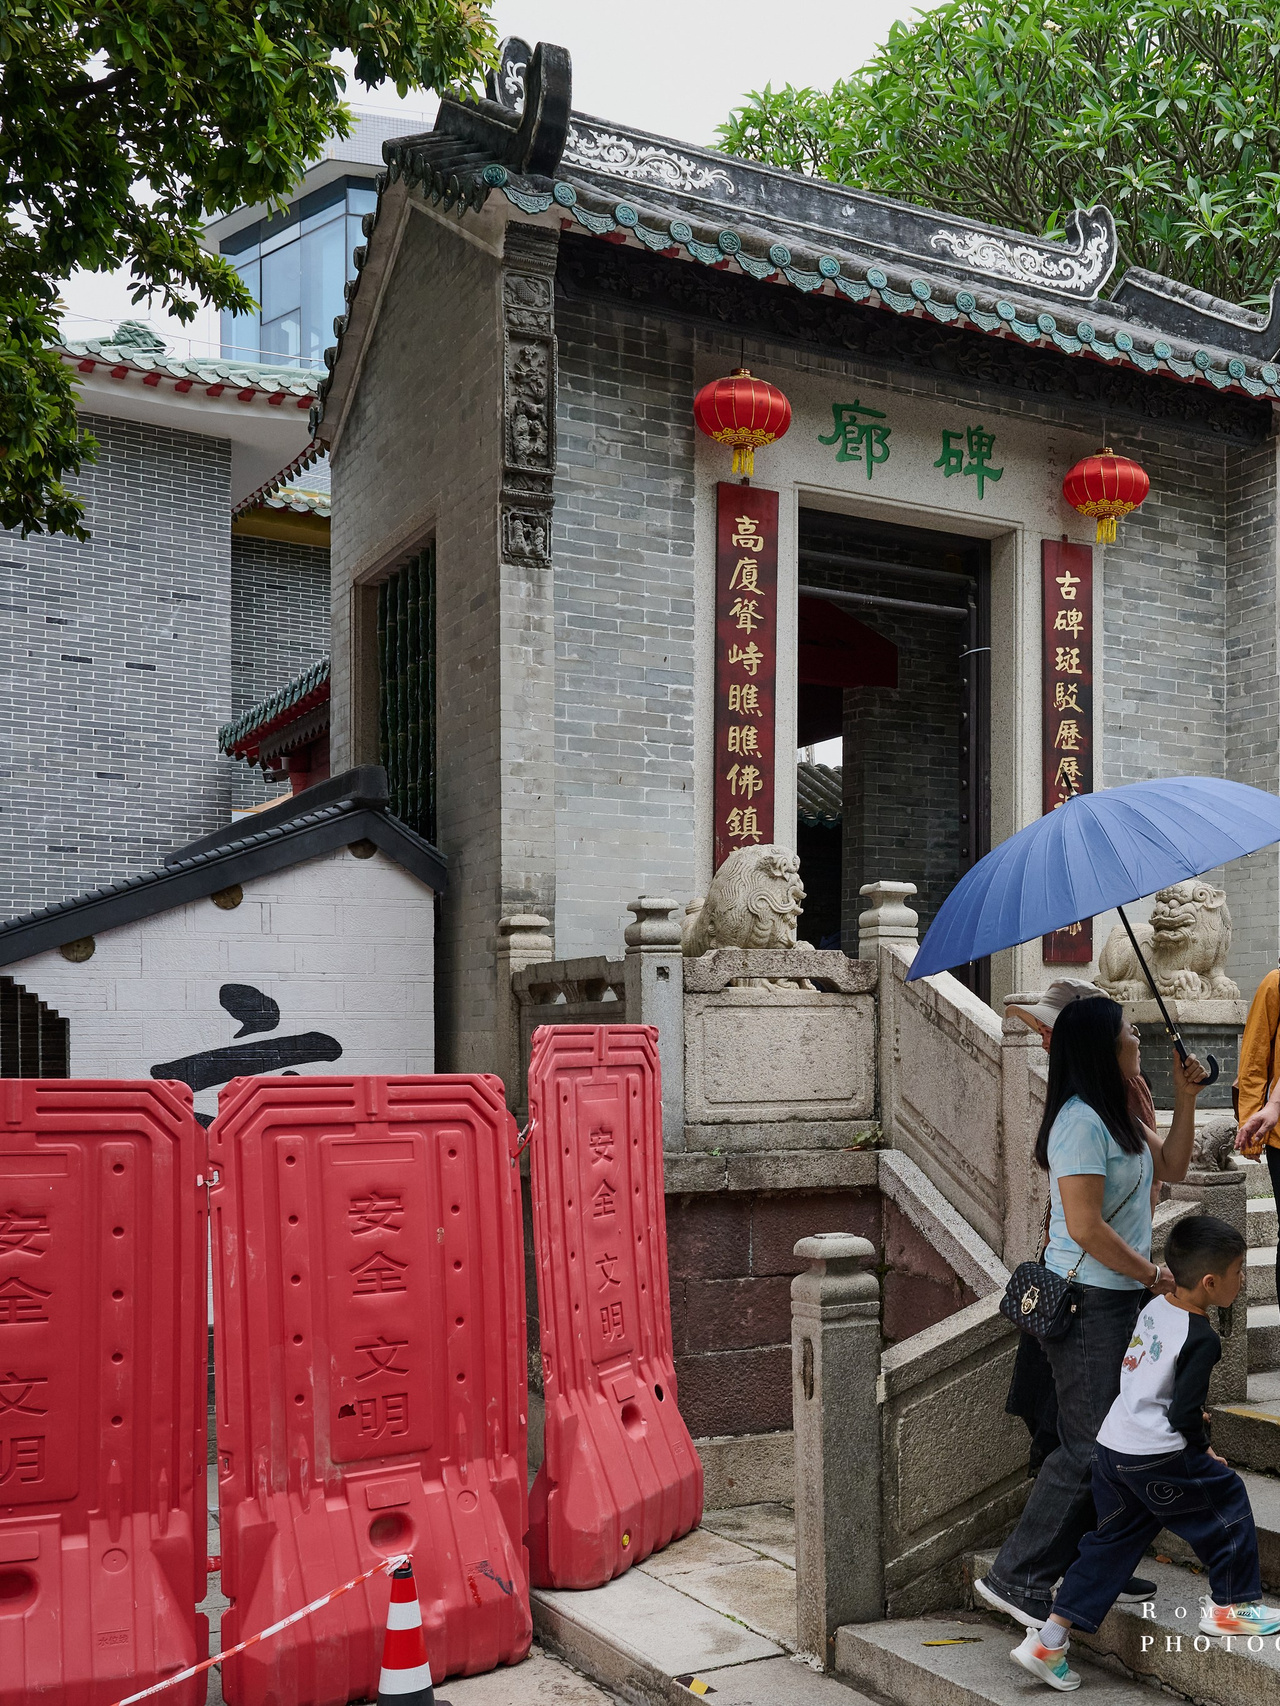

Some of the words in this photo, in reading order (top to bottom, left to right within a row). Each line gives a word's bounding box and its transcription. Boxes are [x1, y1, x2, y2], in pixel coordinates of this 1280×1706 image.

[726, 515, 766, 851] 高廈聳峙瞧瞧佛鎮
[348, 1191, 410, 1440] 安全文明
[588, 1127, 626, 1343] 安全文明
